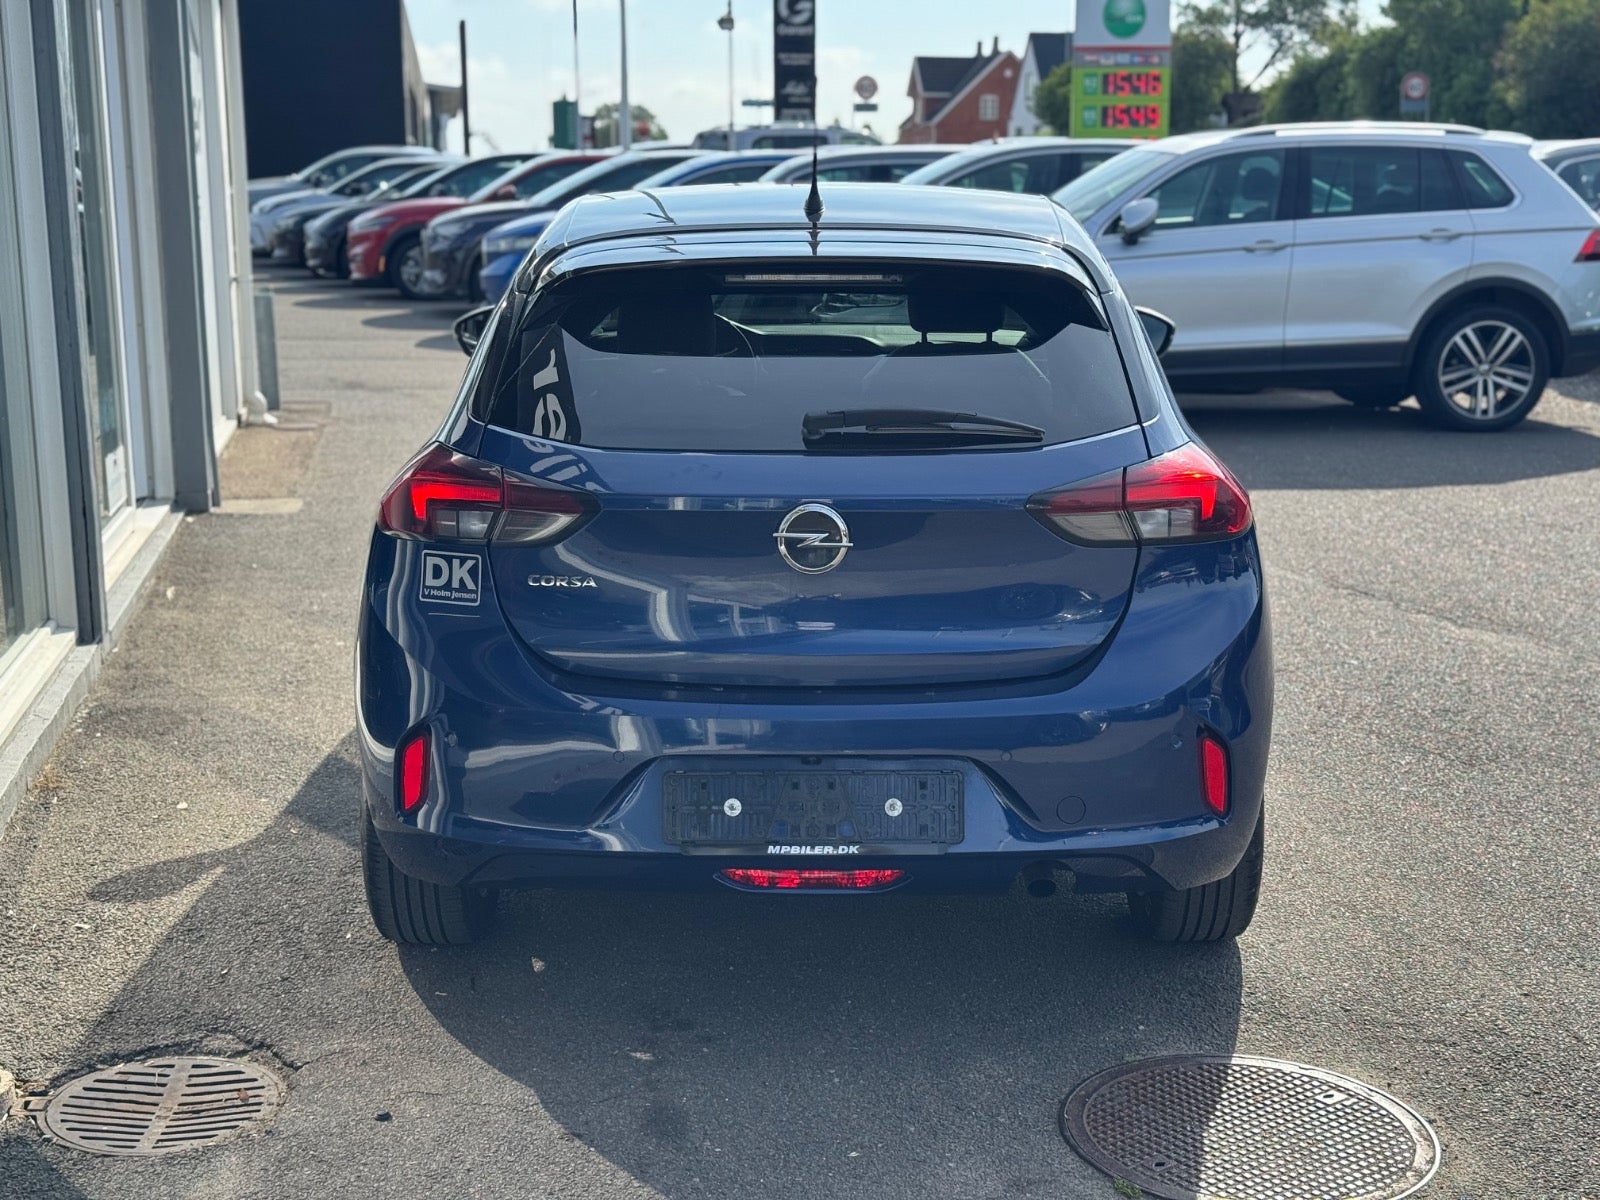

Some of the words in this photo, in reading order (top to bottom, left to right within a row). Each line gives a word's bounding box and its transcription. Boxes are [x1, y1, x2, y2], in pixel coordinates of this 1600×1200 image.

[425, 555, 477, 591] DK
[527, 574, 598, 587] CORSA
[424, 588, 430, 596] V
[430, 588, 451, 597] Holm
[767, 845, 860, 854] MPBILER.DK
